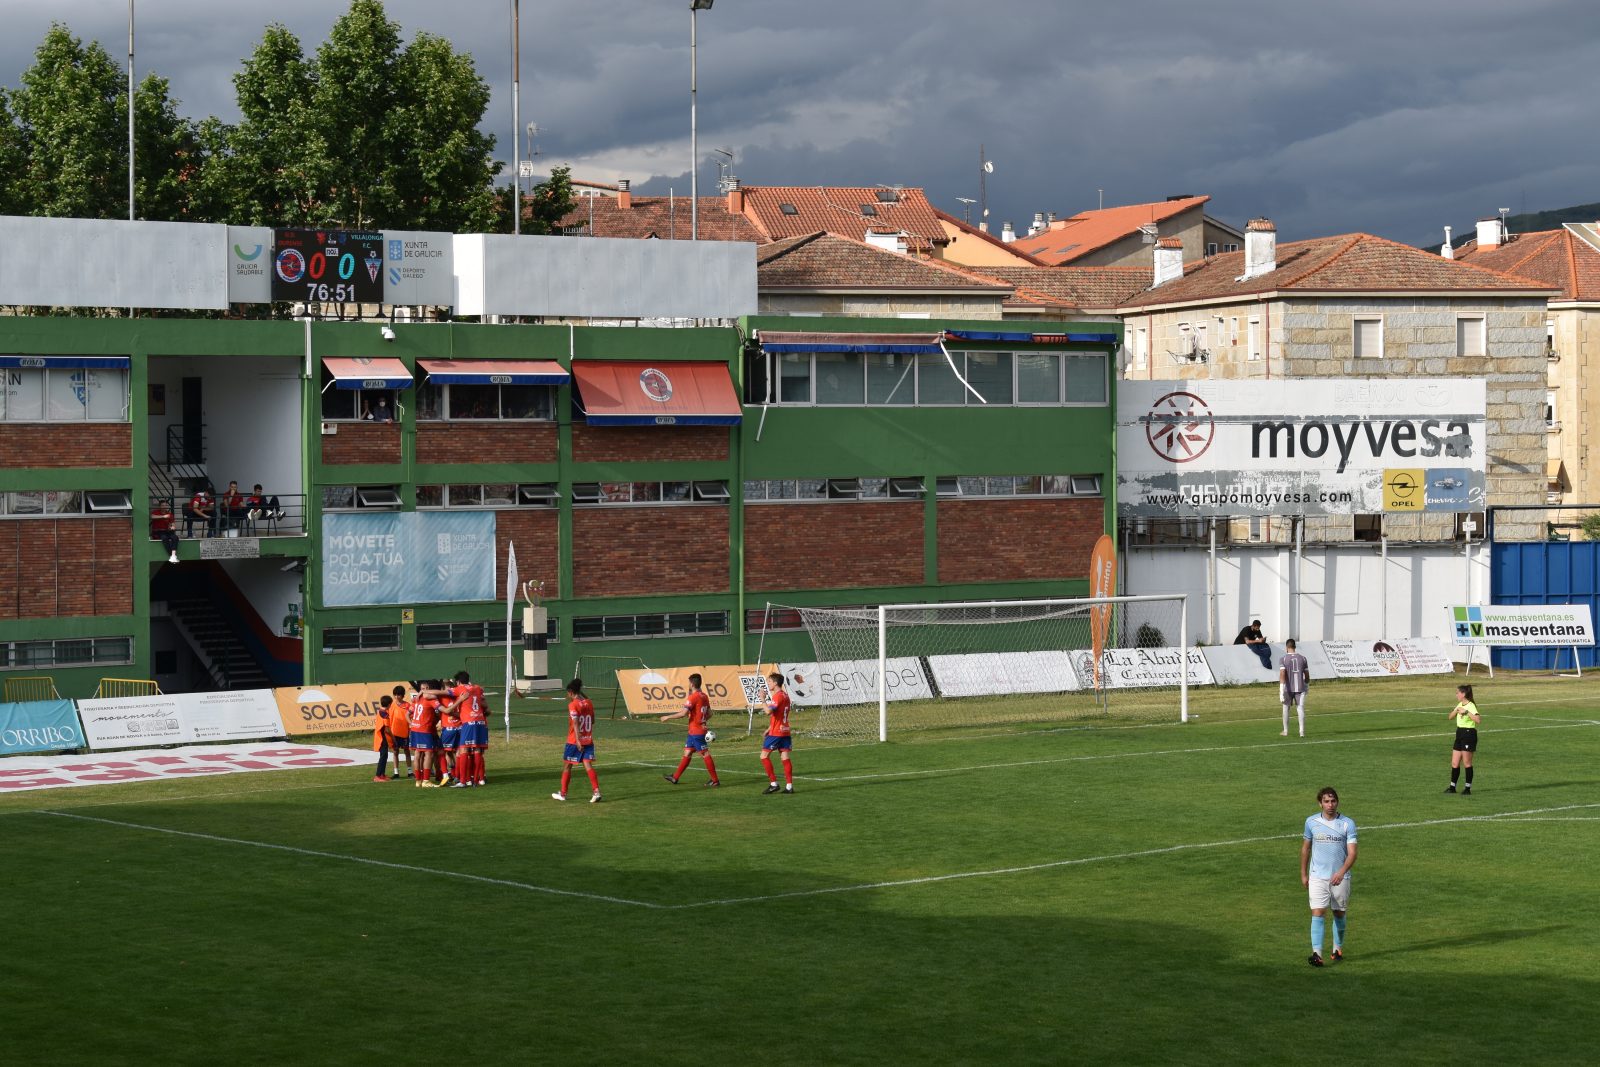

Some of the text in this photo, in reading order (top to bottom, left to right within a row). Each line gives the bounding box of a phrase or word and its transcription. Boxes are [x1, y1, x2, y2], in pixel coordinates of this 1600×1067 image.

[309, 252, 326, 279] 0
[338, 253, 355, 279] 0
[307, 283, 355, 302] 76:51
[365, 380, 384, 388] ROMA
[1251, 420, 1472, 474] moyvesa
[1146, 493, 1352, 507] www.grupomoyvesa.com
[329, 531, 395, 549] MÓVETE
[453, 534, 476, 542] XUNTA
[463, 542, 490, 550] GALICIA
[329, 549, 404, 567] POLA TÚA
[329, 567, 379, 585] SAÚDE
[1485, 613, 1575, 622] www.masventana.es
[1486, 623, 1586, 636] masventana
[1103, 651, 1133, 667] La
[1290, 658, 1300, 673] 1
[821, 657, 925, 694] servpel
[642, 683, 728, 701] SOLGEO
[413, 703, 424, 721] 19
[472, 696, 479, 711] 6
[579, 714, 592, 733] 20
[2, 725, 75, 746] ORRIBO
